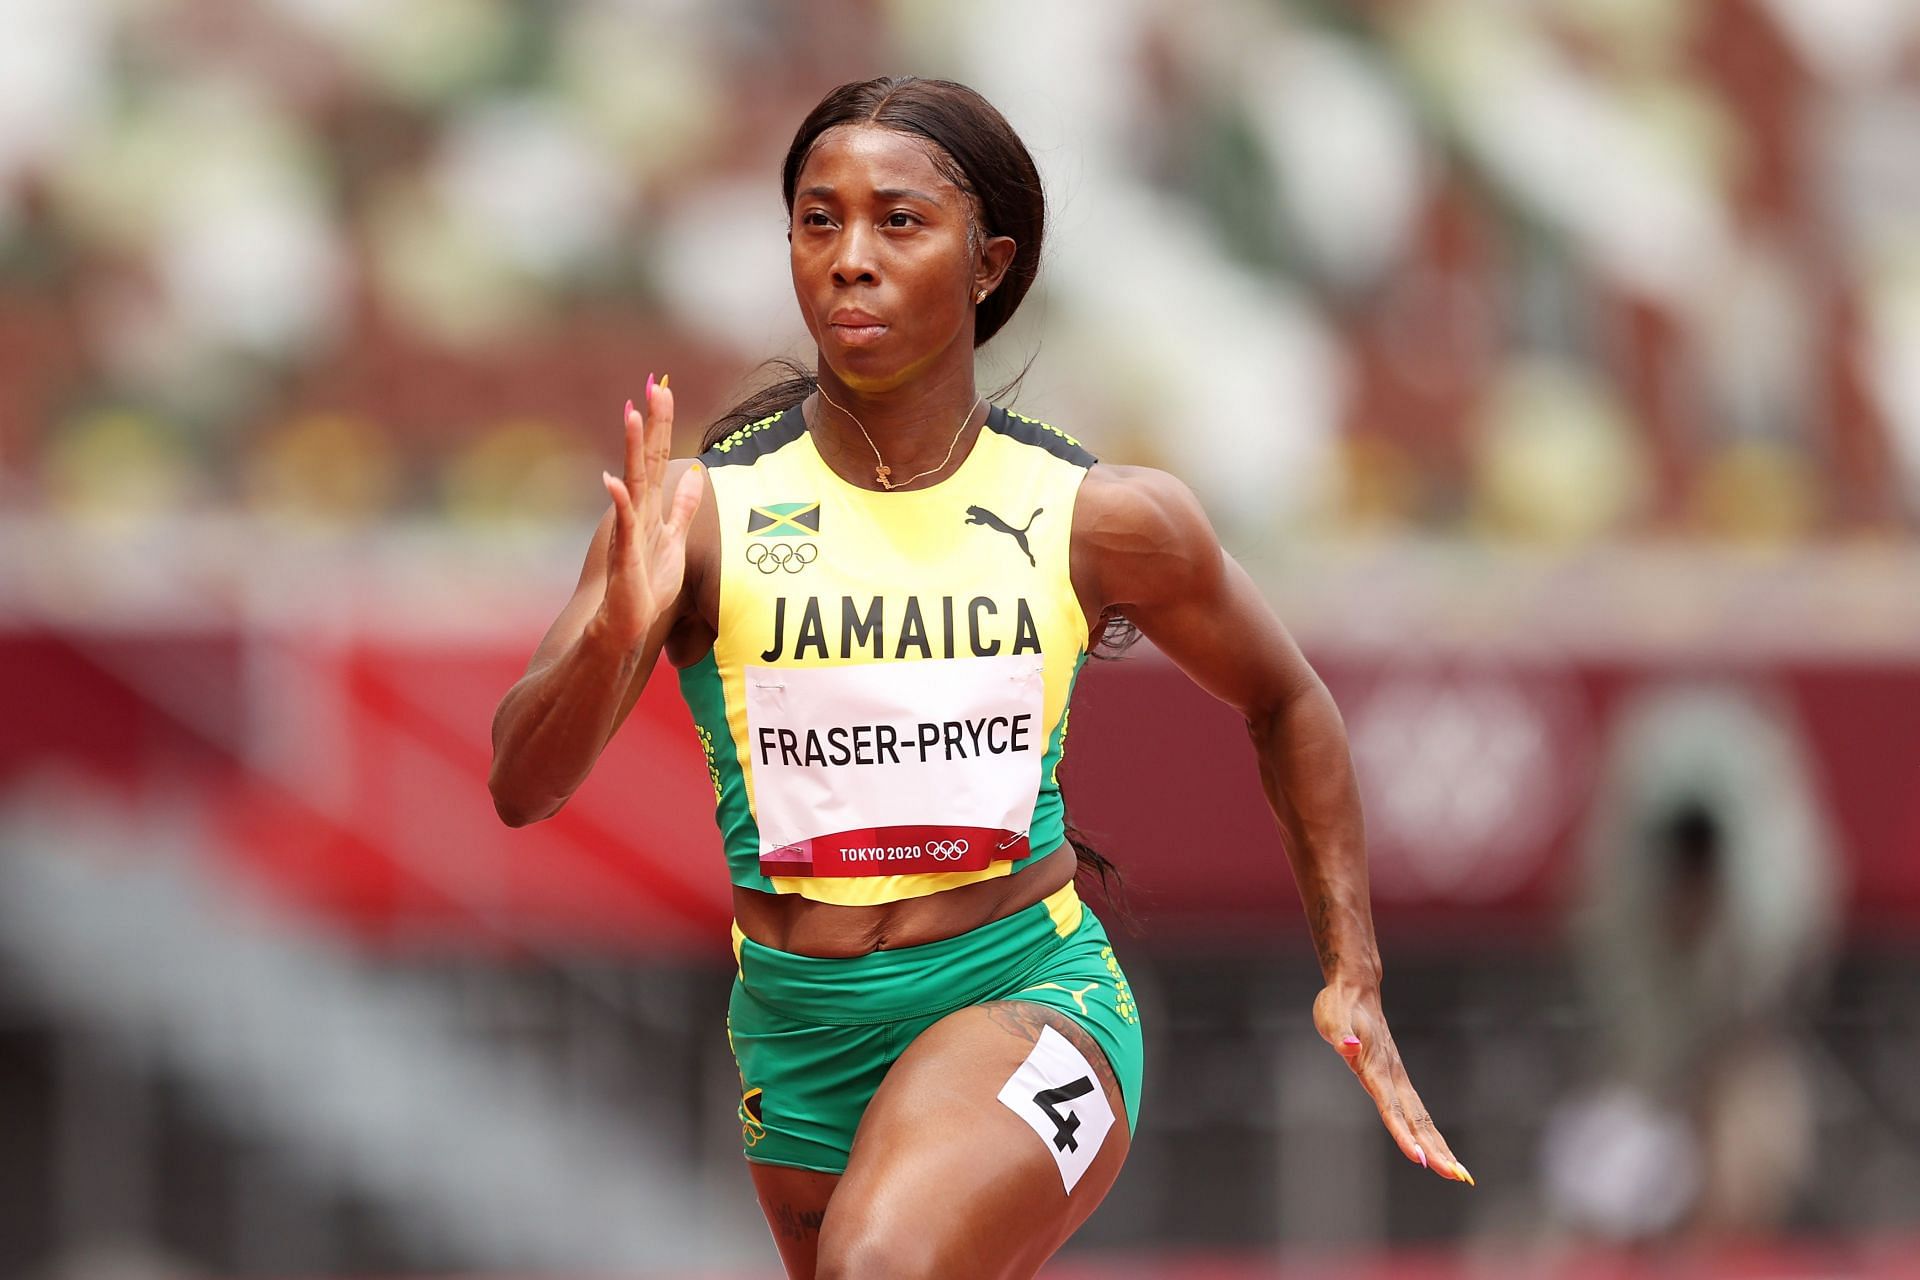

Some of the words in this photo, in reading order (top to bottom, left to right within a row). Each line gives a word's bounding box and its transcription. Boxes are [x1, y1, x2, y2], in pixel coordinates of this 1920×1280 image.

[761, 596, 1042, 662] JAMAICA
[758, 714, 1032, 767] FRASER-PRYCE
[840, 848, 884, 862] TOKYO
[887, 845, 921, 860] 2020
[1032, 1075, 1095, 1154] 4
